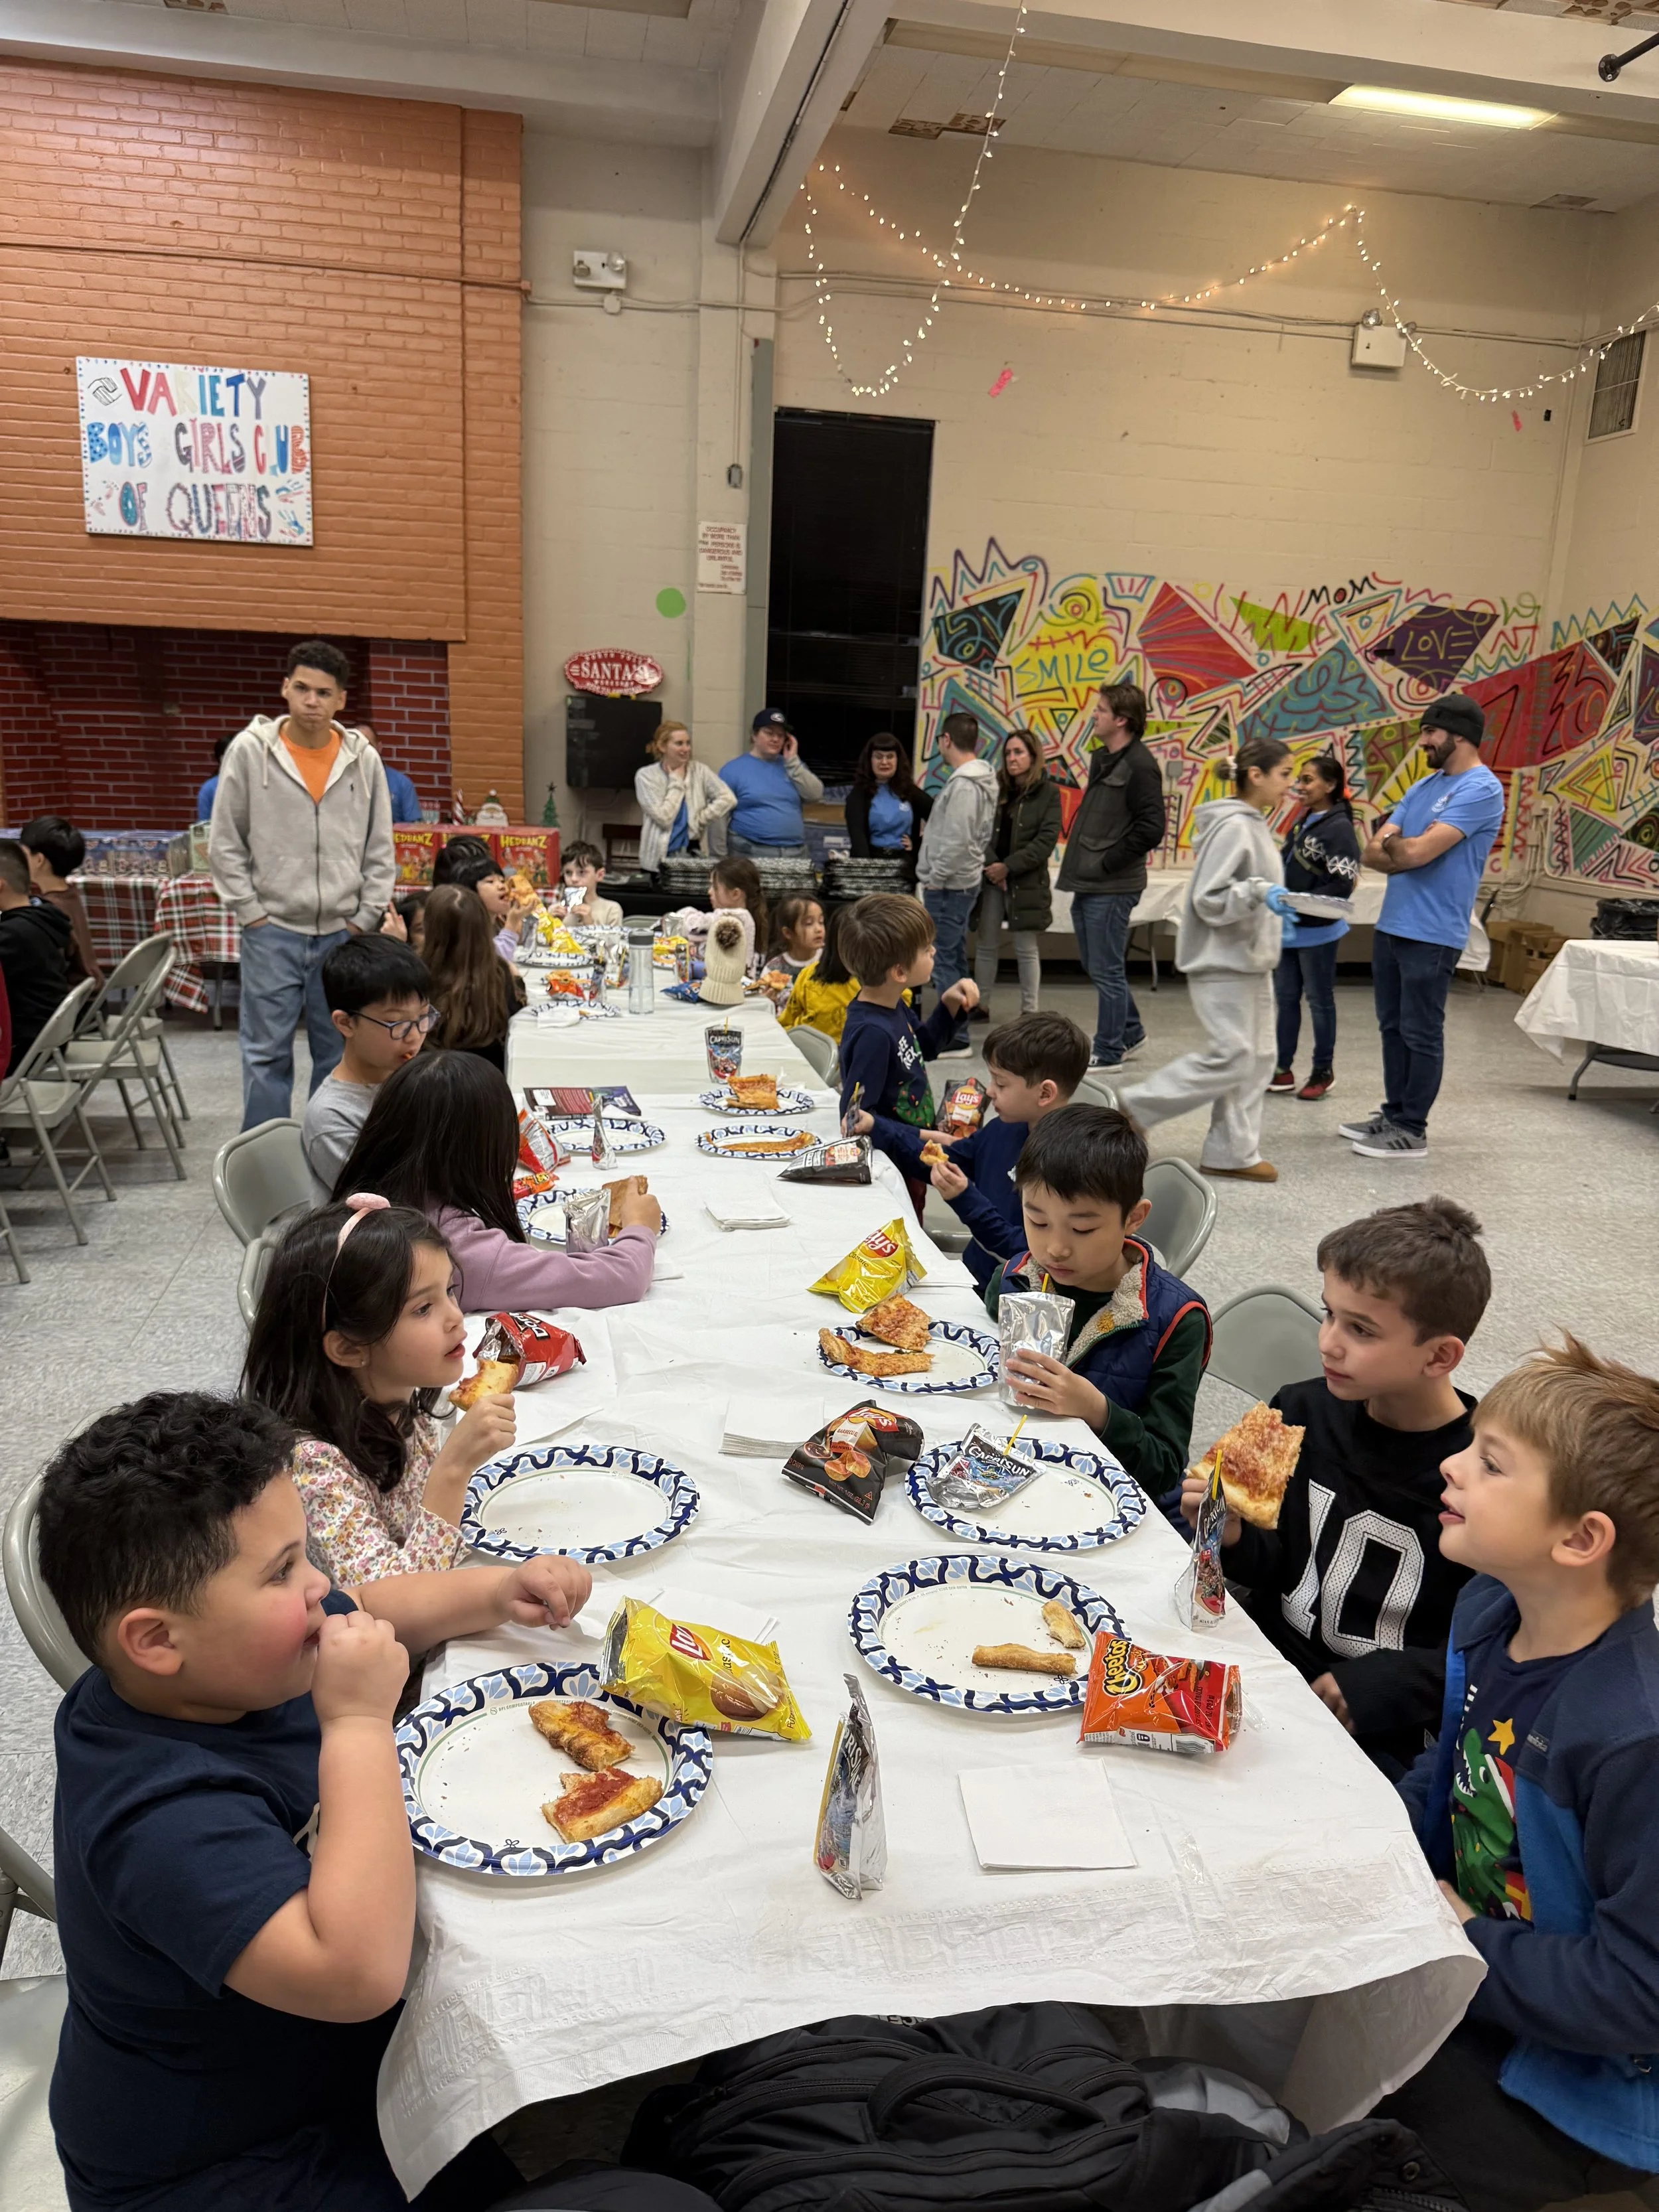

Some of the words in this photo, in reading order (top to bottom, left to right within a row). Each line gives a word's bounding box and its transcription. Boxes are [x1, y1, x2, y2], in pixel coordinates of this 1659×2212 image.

[119, 368, 266, 419] VARIETY
[87, 421, 153, 469] BOYS
[175, 417, 246, 473] GIRLS
[118, 481, 147, 531] OF
[166, 482, 272, 539] QUEENS
[1402, 626, 1475, 661] LOVE
[837, 1428, 859, 1438] BARBECUE
[1281, 1479, 1425, 1658] 10
[1104, 1639, 1141, 1695] Cheetos
